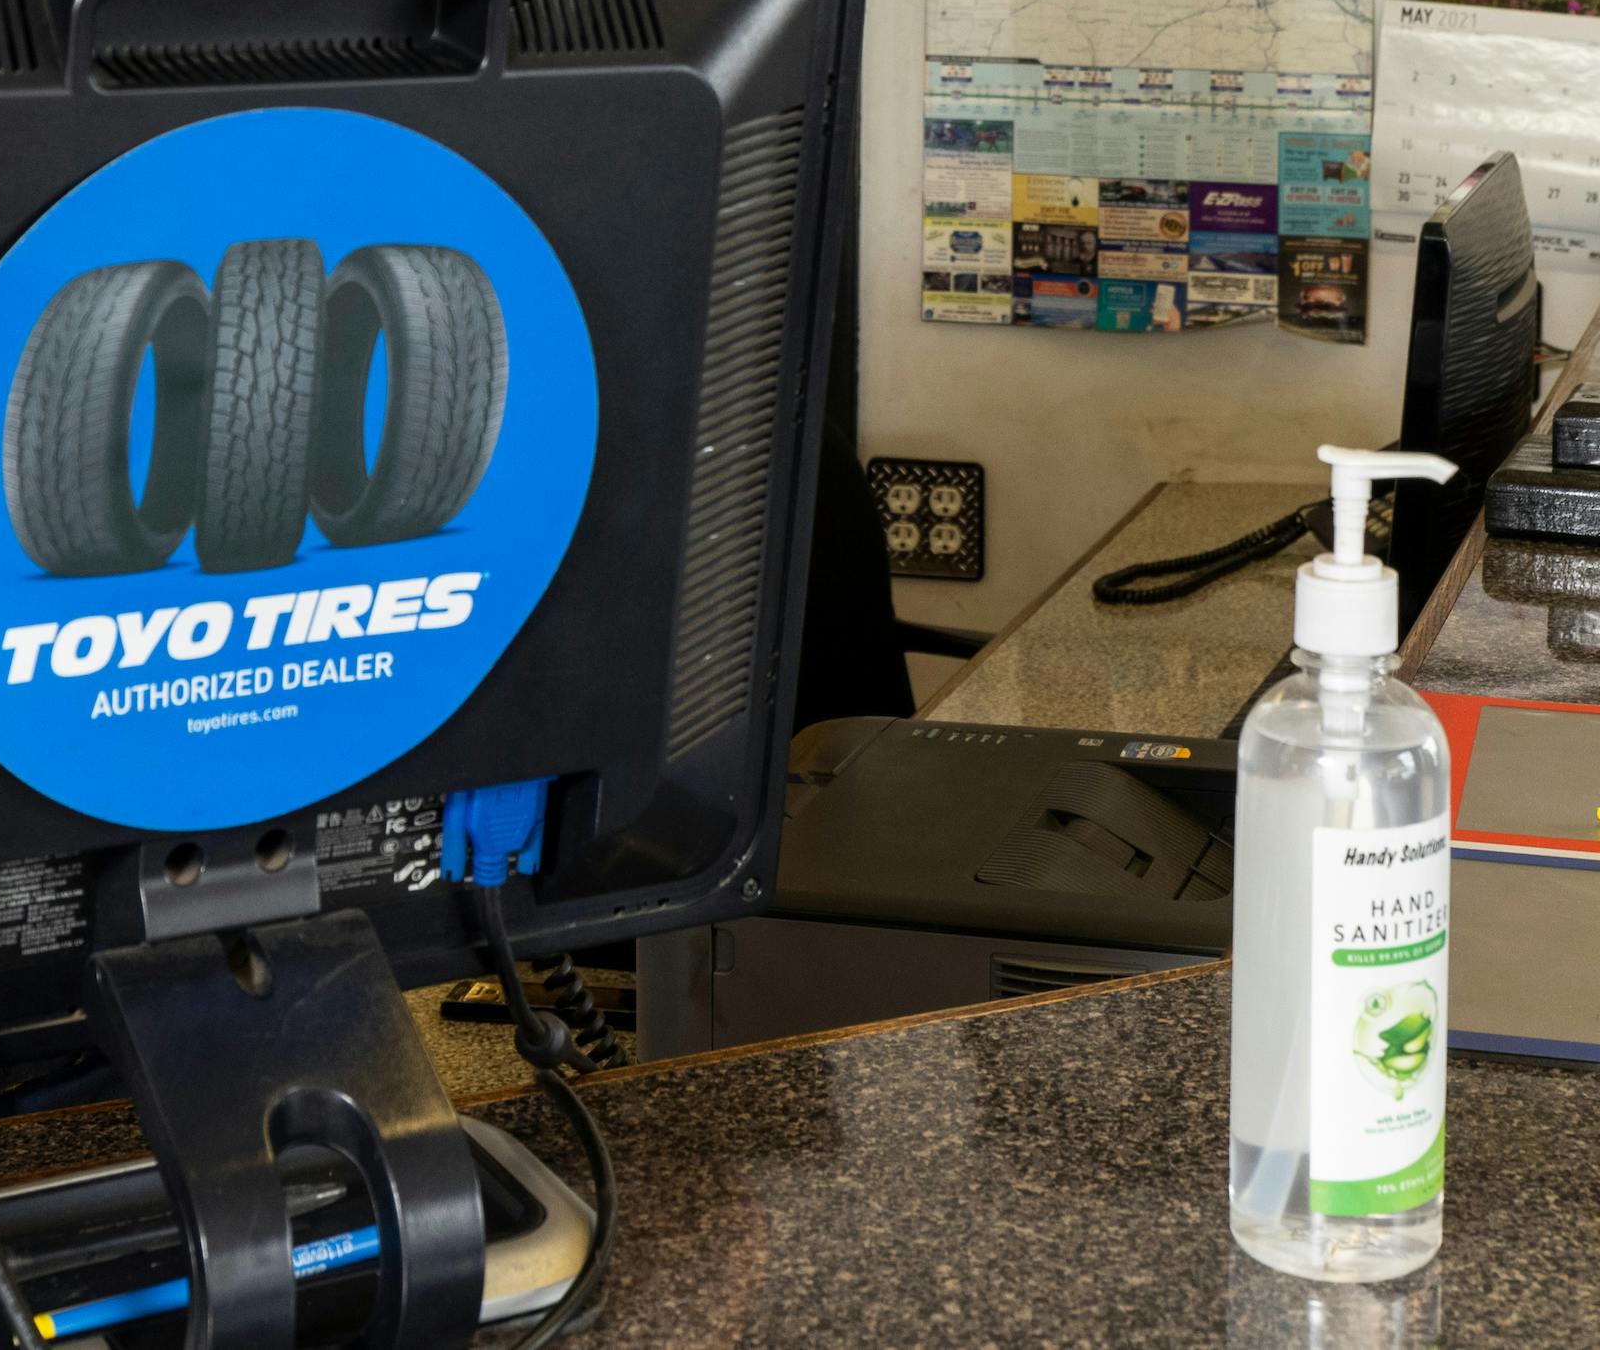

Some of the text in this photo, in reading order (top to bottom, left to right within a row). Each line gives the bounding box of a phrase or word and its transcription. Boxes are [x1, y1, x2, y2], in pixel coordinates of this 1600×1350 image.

[1400, 6, 1479, 29] MAY 2021
[1398, 172, 1411, 185] 23
[1435, 176, 1448, 189] 24
[1547, 187, 1561, 200] 27
[1585, 191, 1599, 204] 28
[0, 571, 483, 687] TOYO TIRES
[89, 651, 395, 720] AUTHORIZED DEALER
[185, 703, 300, 735] toyotires.com
[1344, 847, 1398, 869] Handy
[1370, 890, 1435, 918] HAND
